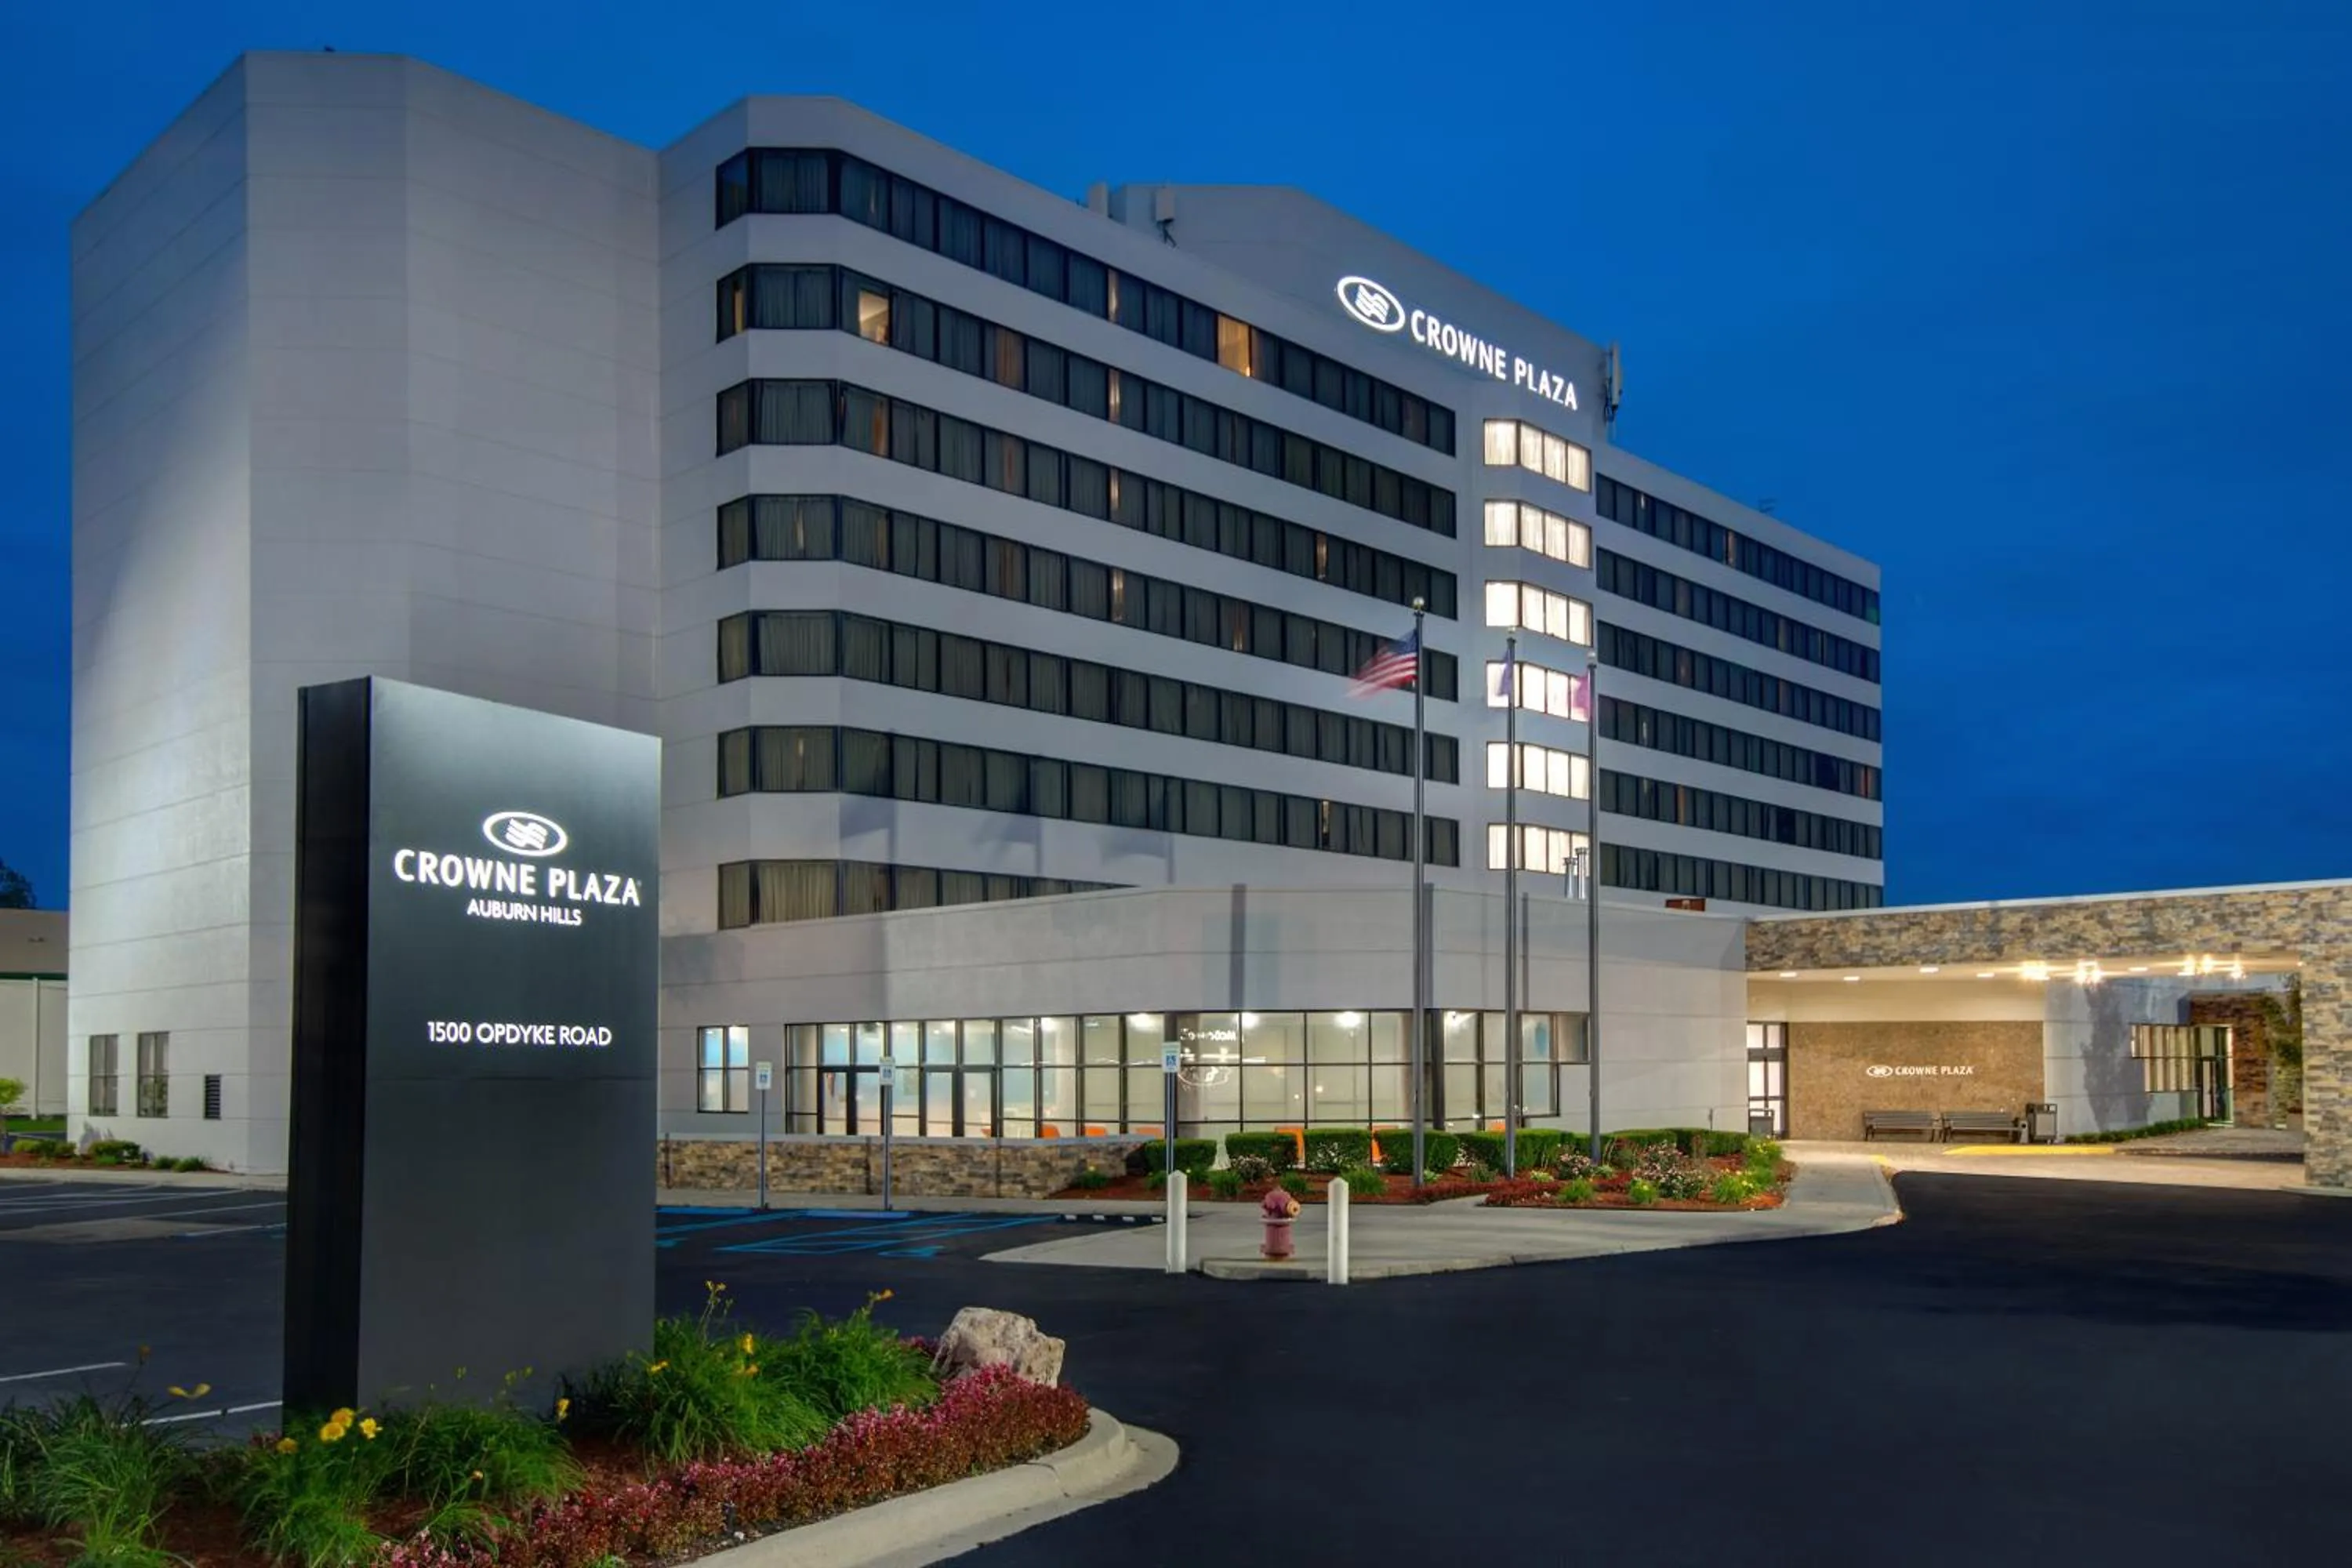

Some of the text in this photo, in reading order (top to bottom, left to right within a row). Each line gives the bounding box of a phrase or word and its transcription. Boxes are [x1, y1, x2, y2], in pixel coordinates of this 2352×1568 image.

[1410, 309, 1577, 411] CROWNE PLAZA
[394, 849, 641, 907] CROWNE PLAZA
[466, 898, 583, 926] AUBURN HILLS
[427, 1022, 612, 1046] 1500 OPDYKE ROAD
[1895, 1065, 1973, 1076] CROWNE PLAZA
